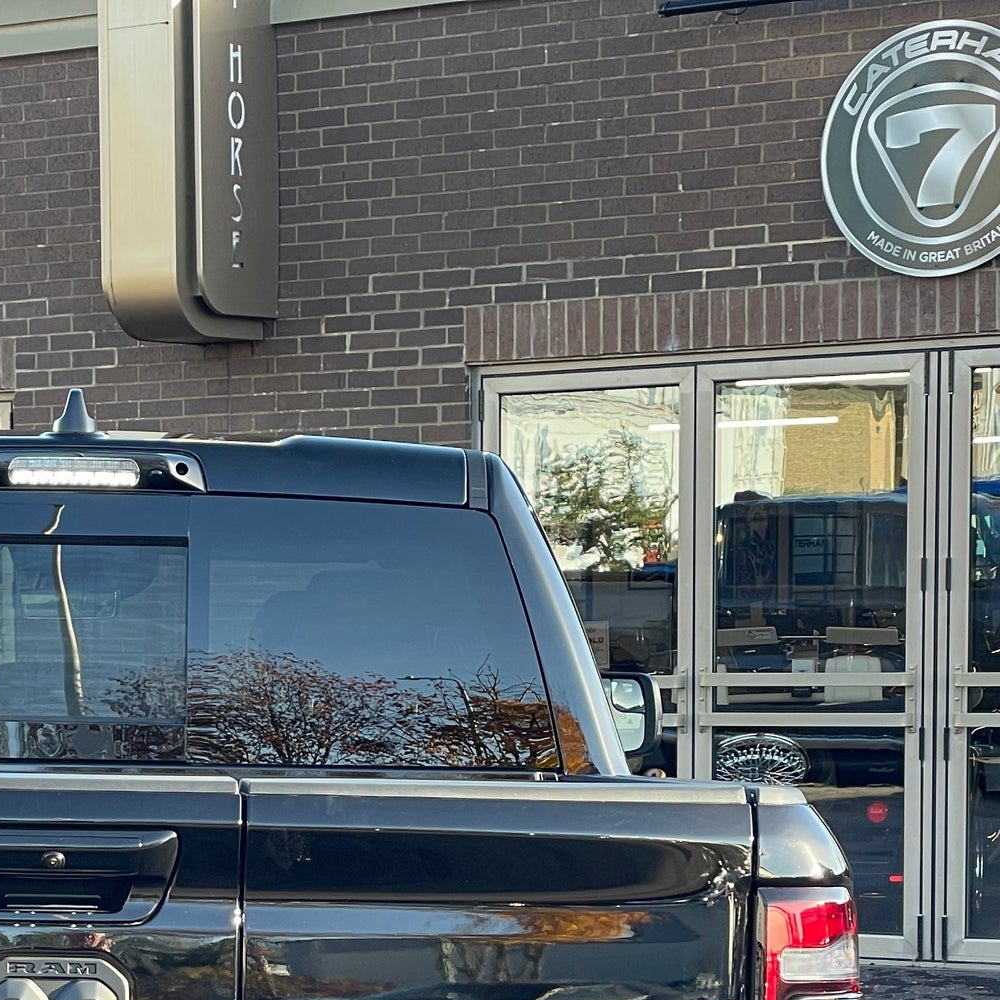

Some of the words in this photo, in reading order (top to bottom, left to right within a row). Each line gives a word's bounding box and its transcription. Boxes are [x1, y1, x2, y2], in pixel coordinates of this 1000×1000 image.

[227, 43, 246, 268] HORSE
[885, 104, 996, 207] 7
[866, 230, 903, 258] MADE
[902, 248, 917, 261] IN
[919, 247, 962, 263] GREAT
[963, 224, 1000, 256] BRITAI
[6, 961, 98, 976] RAM
